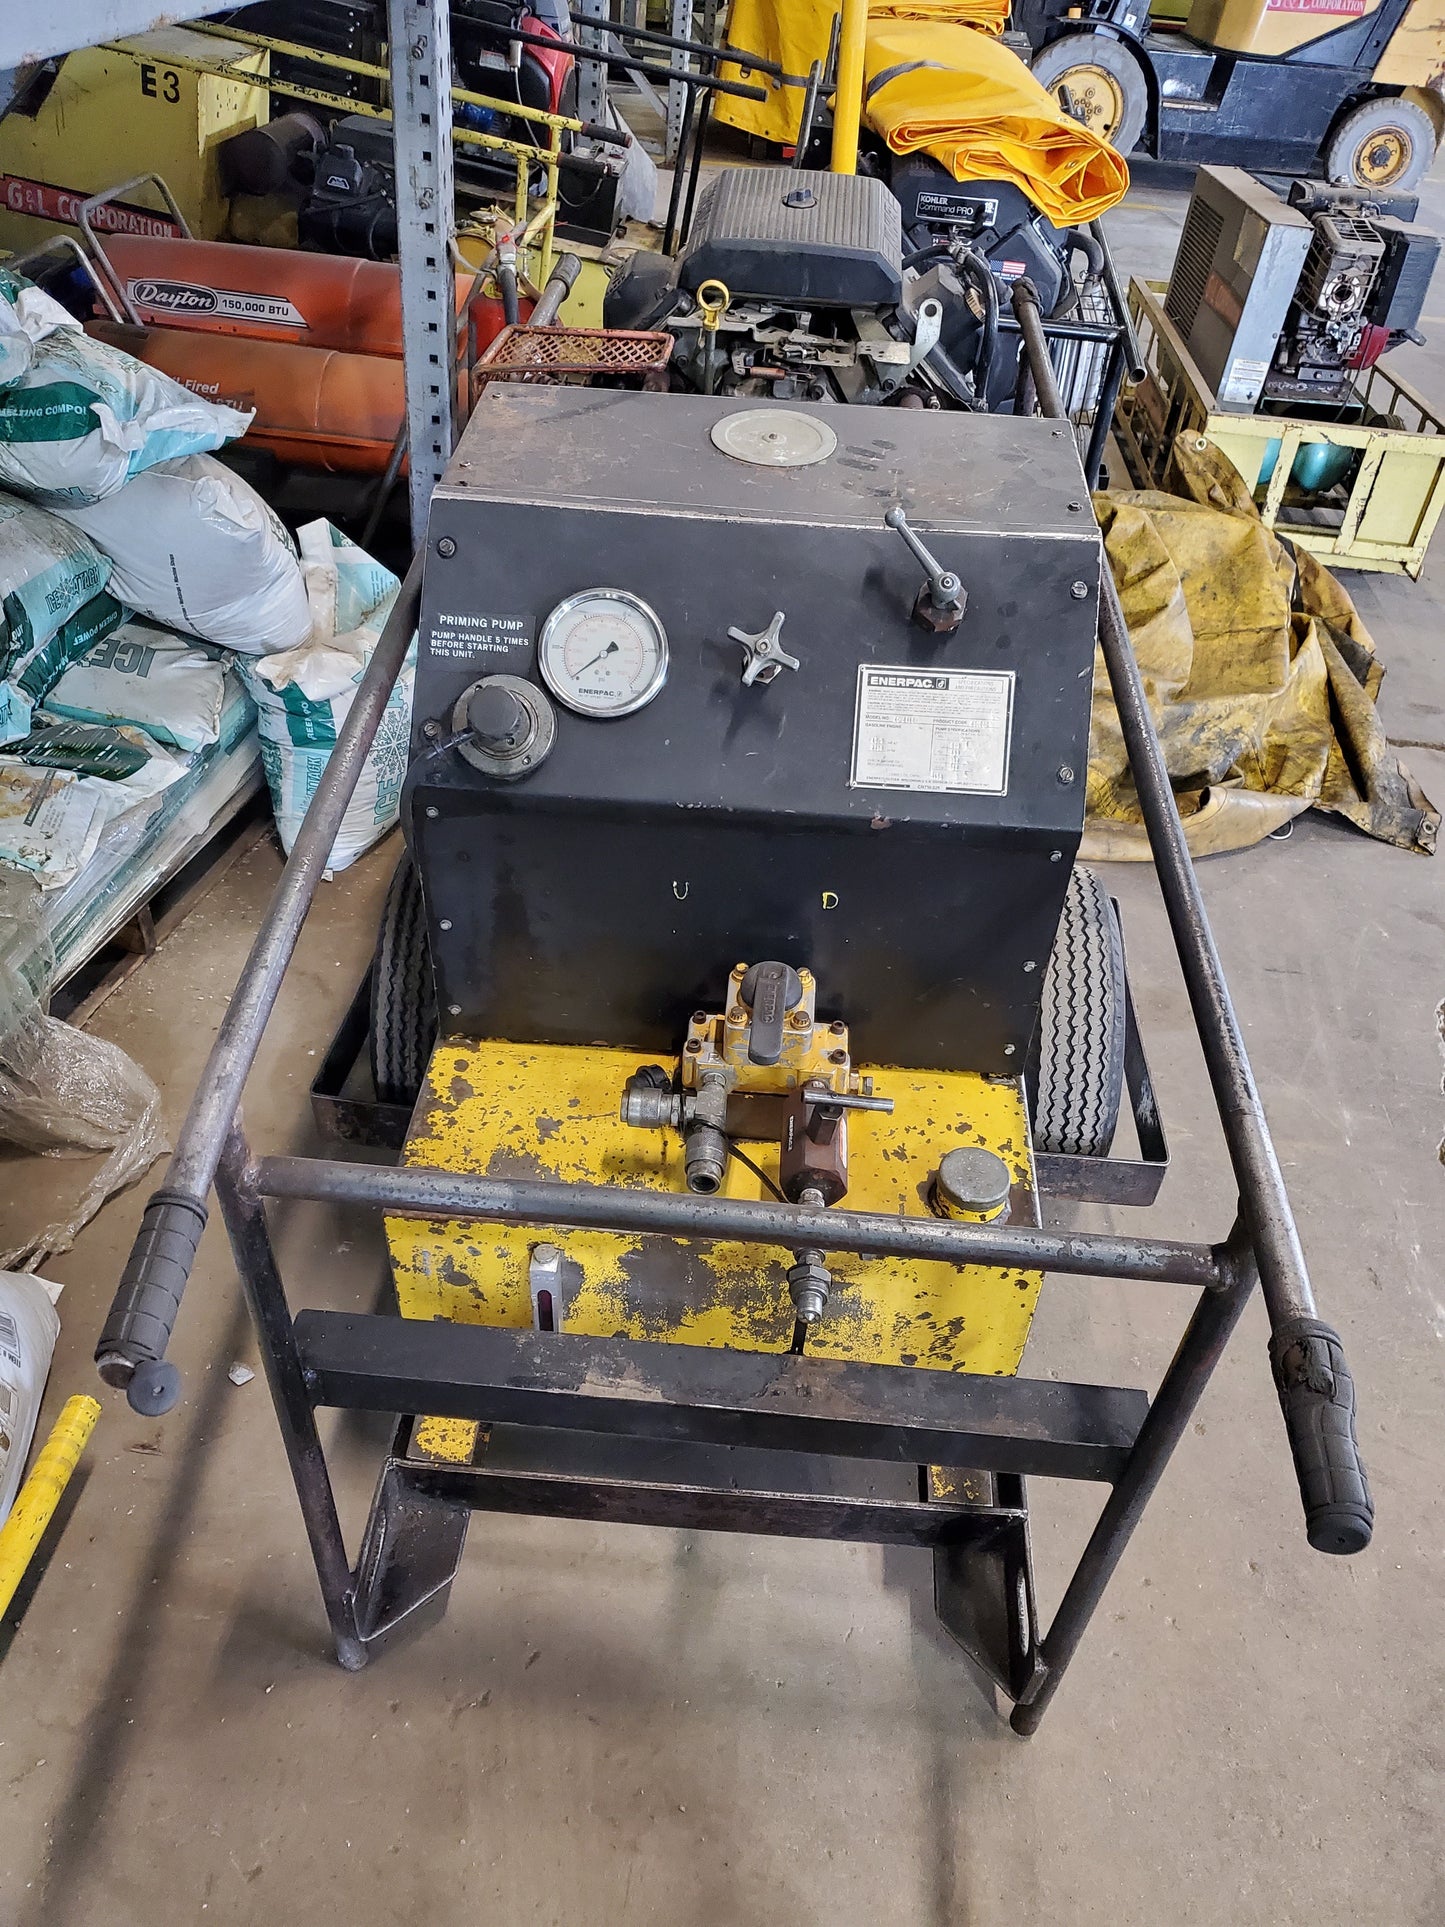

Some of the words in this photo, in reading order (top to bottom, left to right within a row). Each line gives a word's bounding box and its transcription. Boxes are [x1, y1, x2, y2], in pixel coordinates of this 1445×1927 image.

[920, 194, 948, 205] KOHLER
[919, 202, 955, 214] Command
[956, 206, 974, 216] PRO
[137, 284, 213, 309] Dayton
[221, 298, 265, 313] 150,000
[268, 304, 289, 317] BTU
[439, 614, 488, 628] PRIMING
[491, 619, 524, 631] PUMP
[430, 639, 465, 649] BEFORE
[466, 642, 509, 653] STARTING
[431, 630, 456, 640] PUMP
[458, 633, 493, 643] HANDLE
[495, 636, 501, 644] 5
[503, 636, 529, 646] TIMES
[89, 638, 159, 679] ICE
[430, 647, 450, 657] THIS
[452, 650, 476, 659] UNIT.
[373, 773, 401, 826] ICE
[672, 881, 689, 900] U
[822, 891, 839, 910] D
